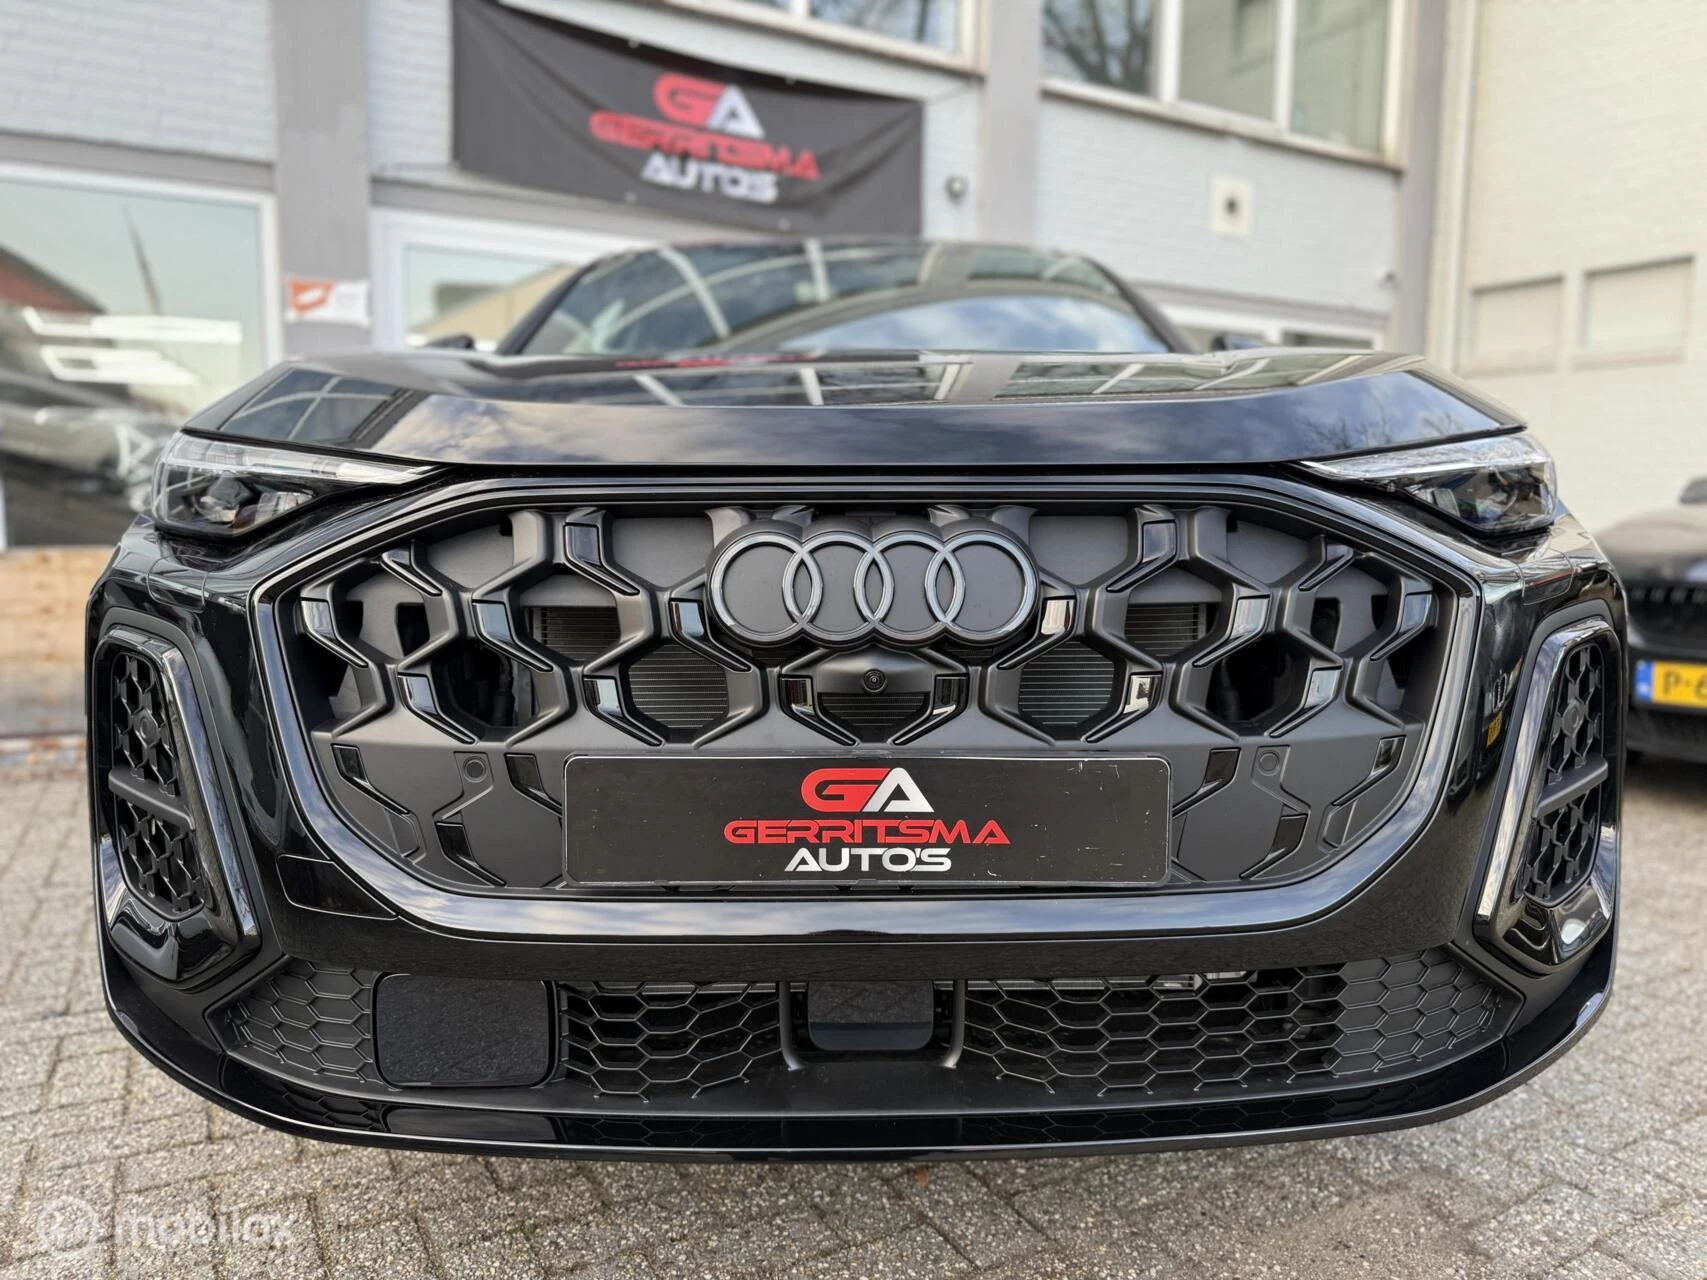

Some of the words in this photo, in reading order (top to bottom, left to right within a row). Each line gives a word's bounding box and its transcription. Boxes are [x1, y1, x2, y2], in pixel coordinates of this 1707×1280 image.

[653, 72, 764, 139] GA
[801, 767, 935, 813] GA
[723, 819, 1011, 845] GERRITSMA
[784, 847, 952, 872] AUTO'S
